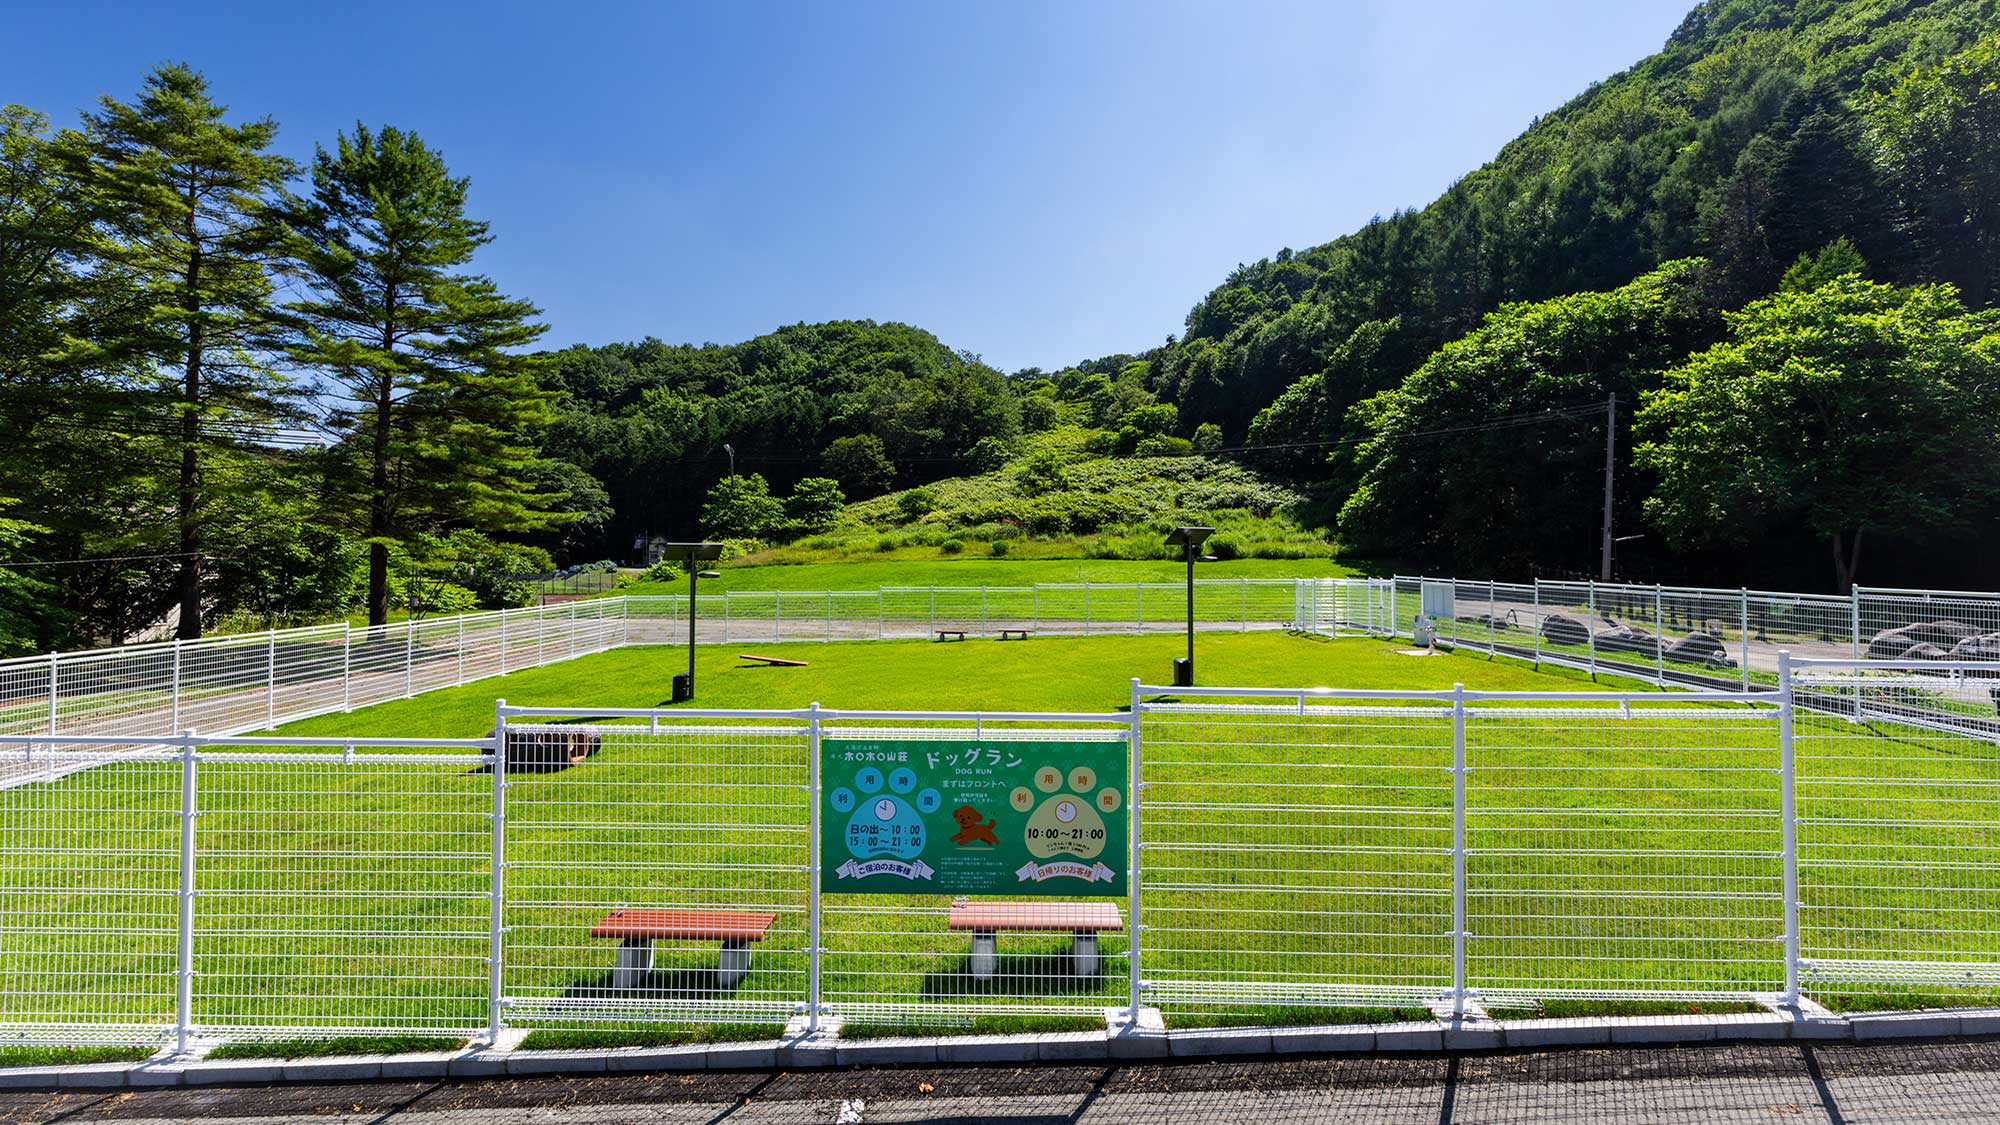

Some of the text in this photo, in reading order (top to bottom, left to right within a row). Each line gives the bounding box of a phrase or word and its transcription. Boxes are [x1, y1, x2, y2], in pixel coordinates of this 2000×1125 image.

[926, 748, 1023, 770] ドッグラン
[942, 779, 1007, 788] まずはフロントへ
[858, 862, 912, 876] ご宿泊のお客様
[1036, 865, 1093, 878] 日帰りのお客様
